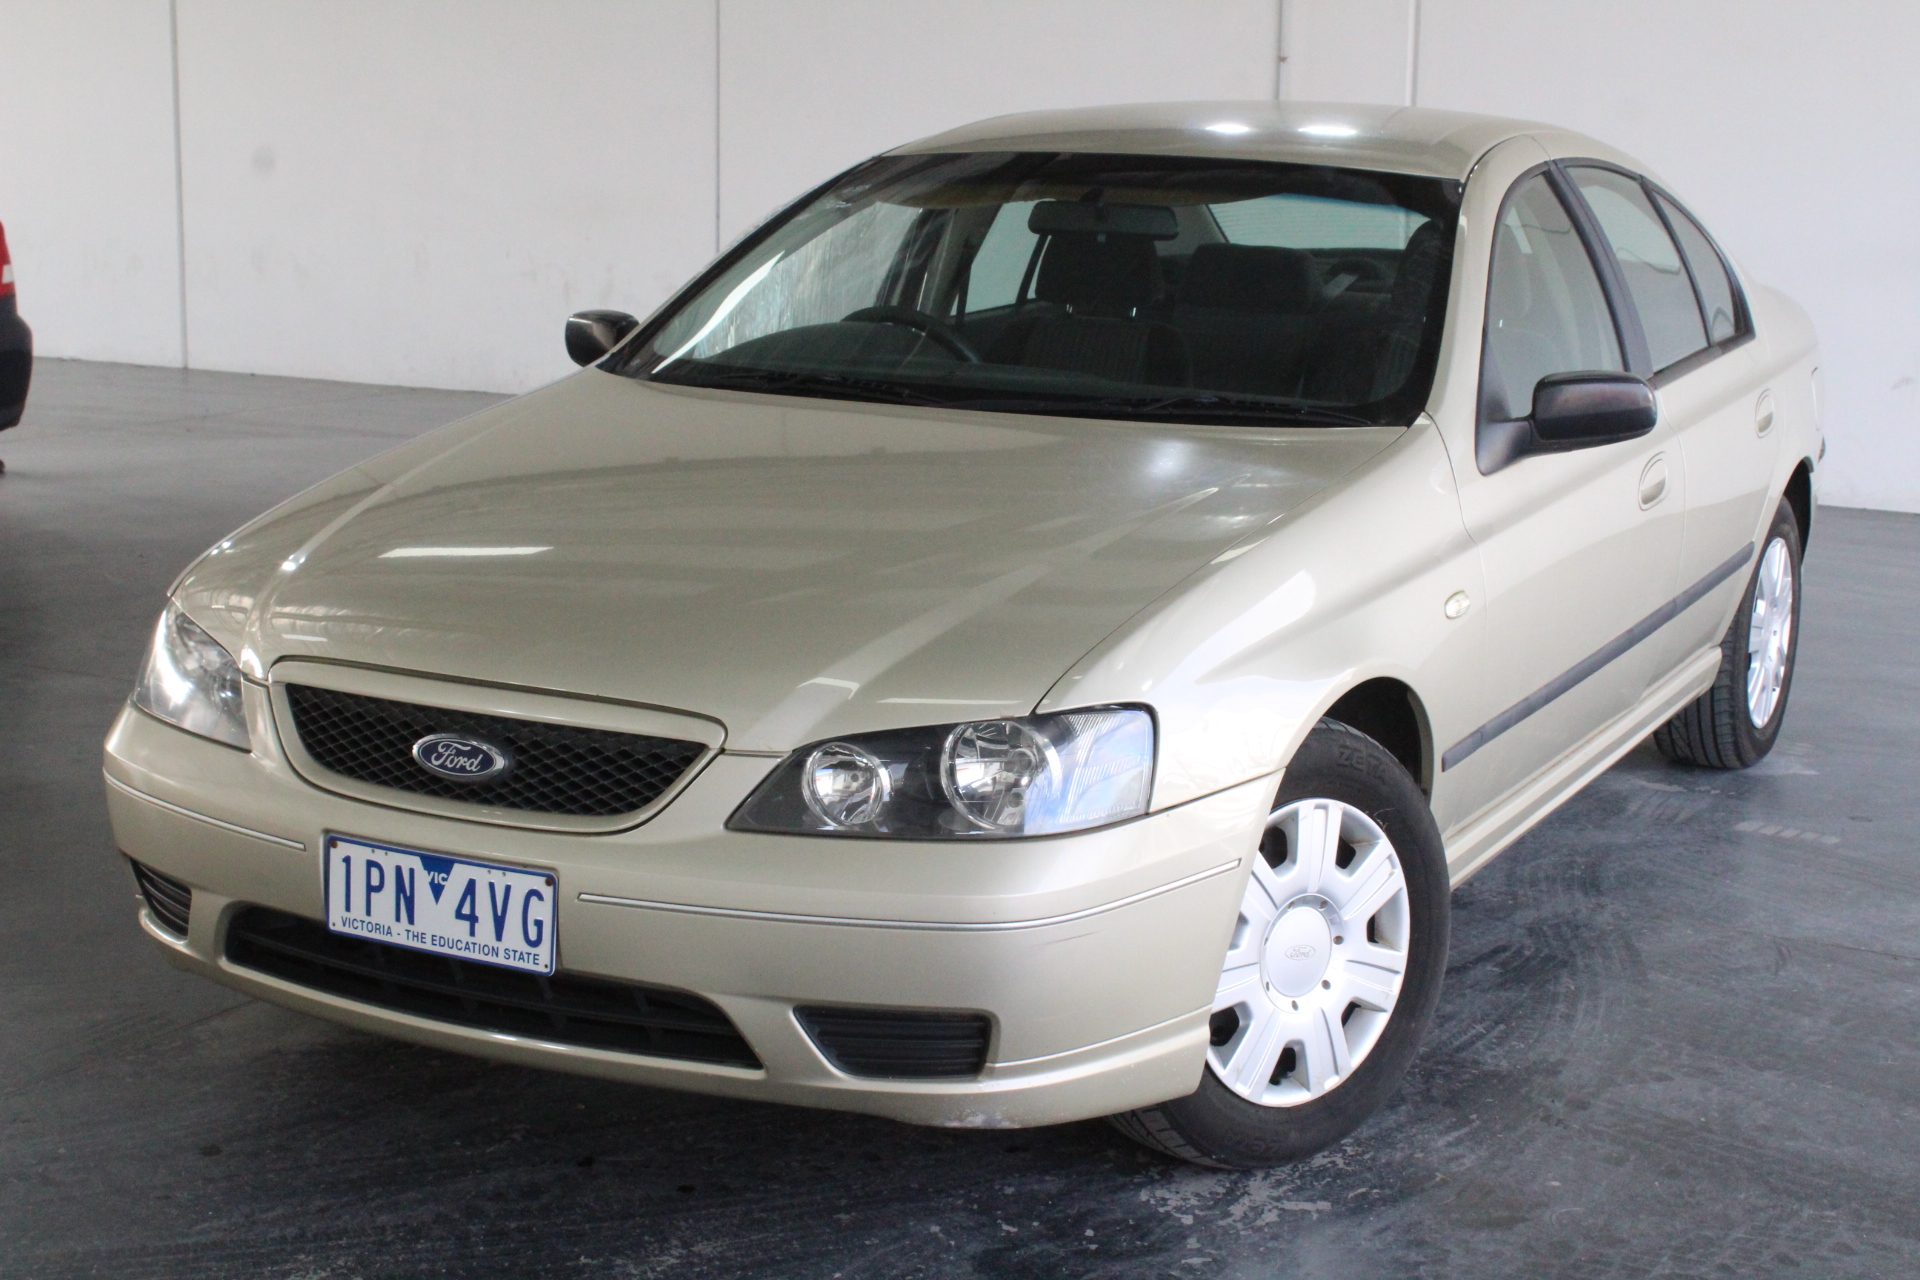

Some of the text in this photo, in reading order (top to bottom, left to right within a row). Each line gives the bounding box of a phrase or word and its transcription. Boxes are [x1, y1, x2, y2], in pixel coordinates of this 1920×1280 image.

[431, 741, 483, 772] Ford
[425, 870, 448, 886] VIC
[342, 855, 544, 949] 1PN 4VG
[341, 916, 393, 938] VICTORIA
[405, 929, 427, 945] THE
[431, 934, 500, 959] EDUCATION
[504, 948, 541, 966] STATE
[1290, 946, 1312, 959] Ford
